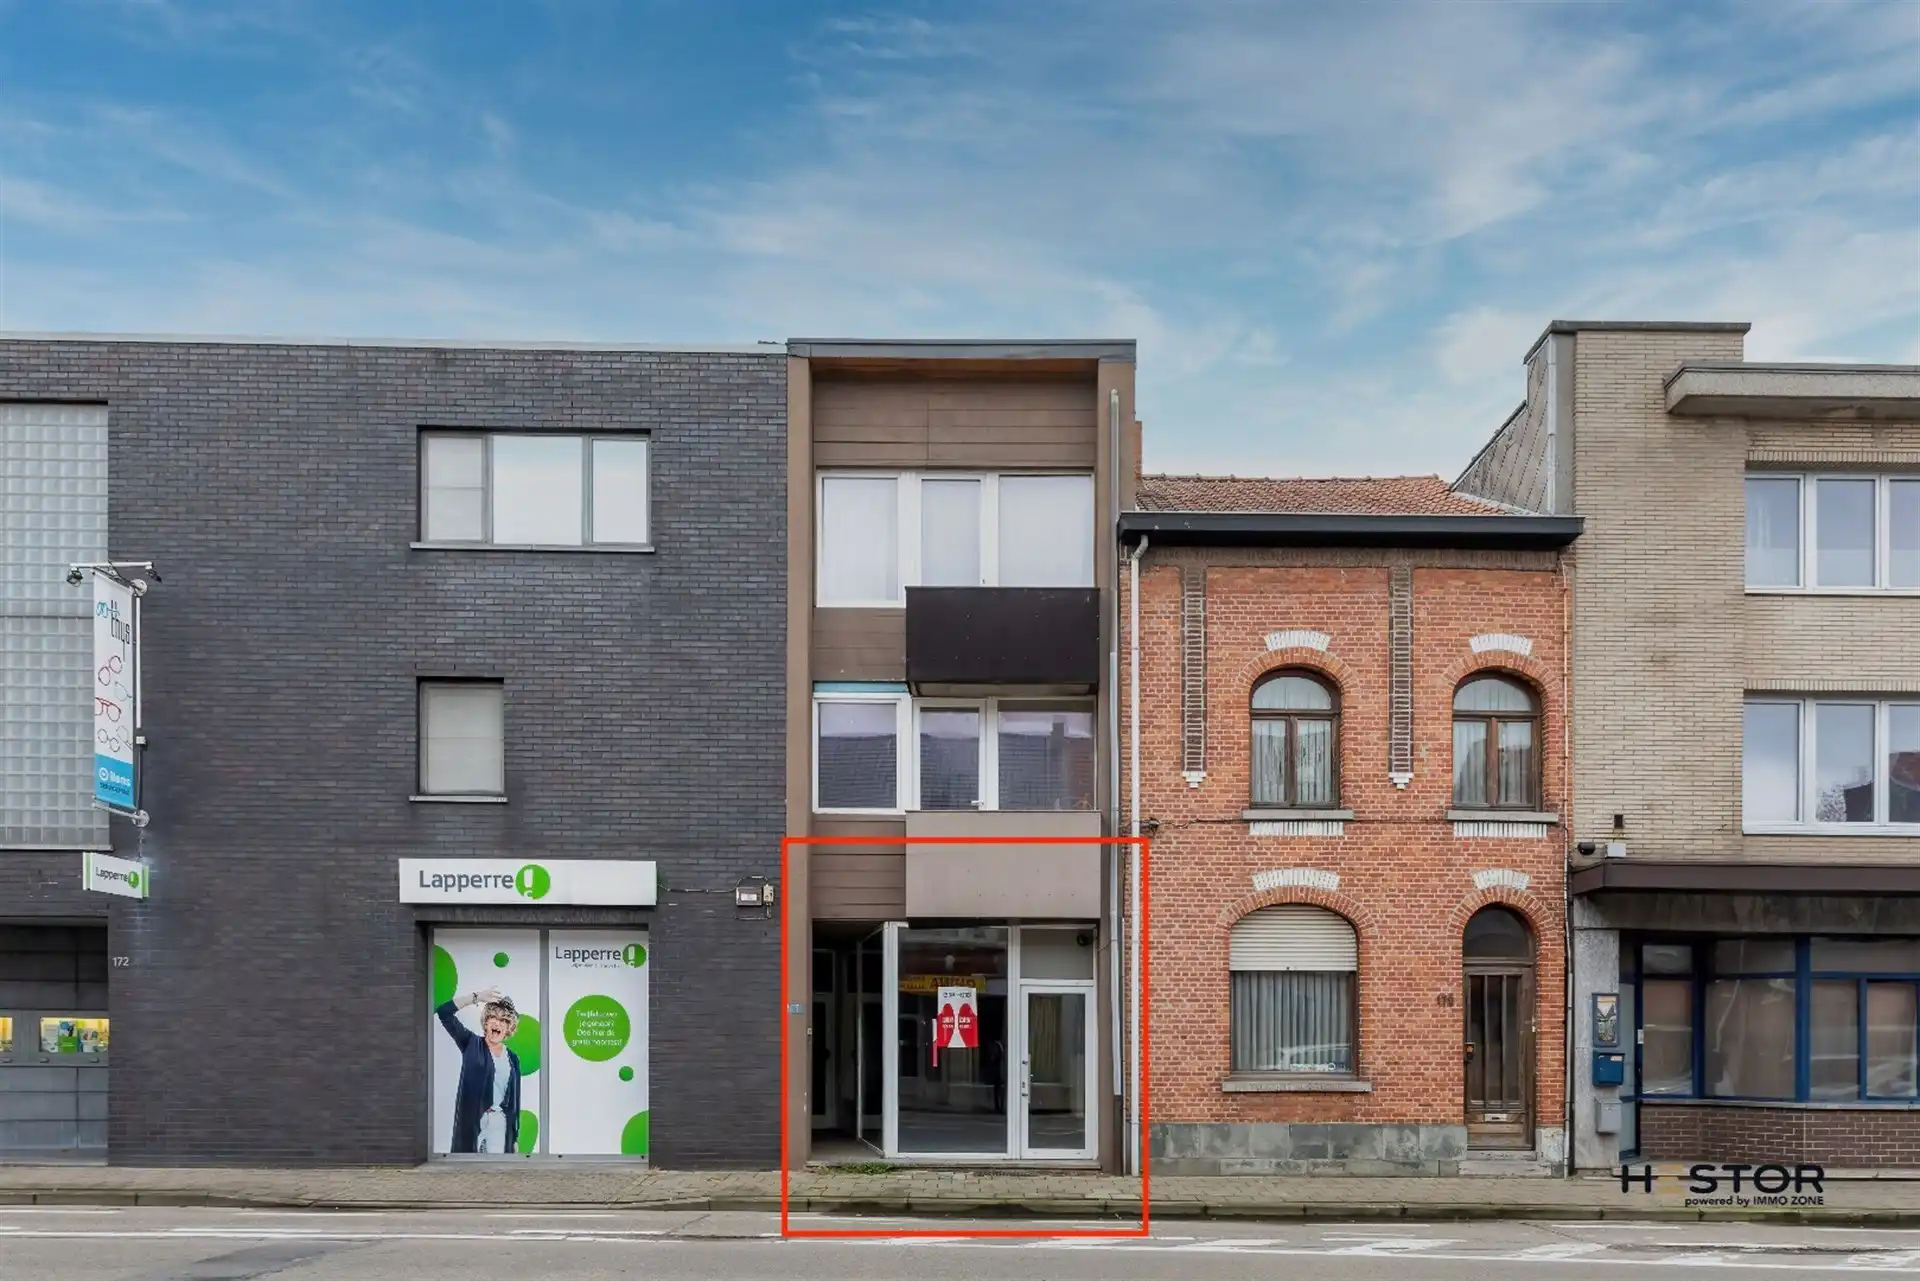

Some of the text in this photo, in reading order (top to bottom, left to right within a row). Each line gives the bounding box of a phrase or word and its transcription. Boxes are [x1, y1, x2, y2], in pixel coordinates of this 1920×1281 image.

[95, 866, 128, 881] Lapperre
[419, 870, 514, 892] Lapperre
[111, 956, 130, 967] 172
[555, 946, 621, 962] Lapperre
